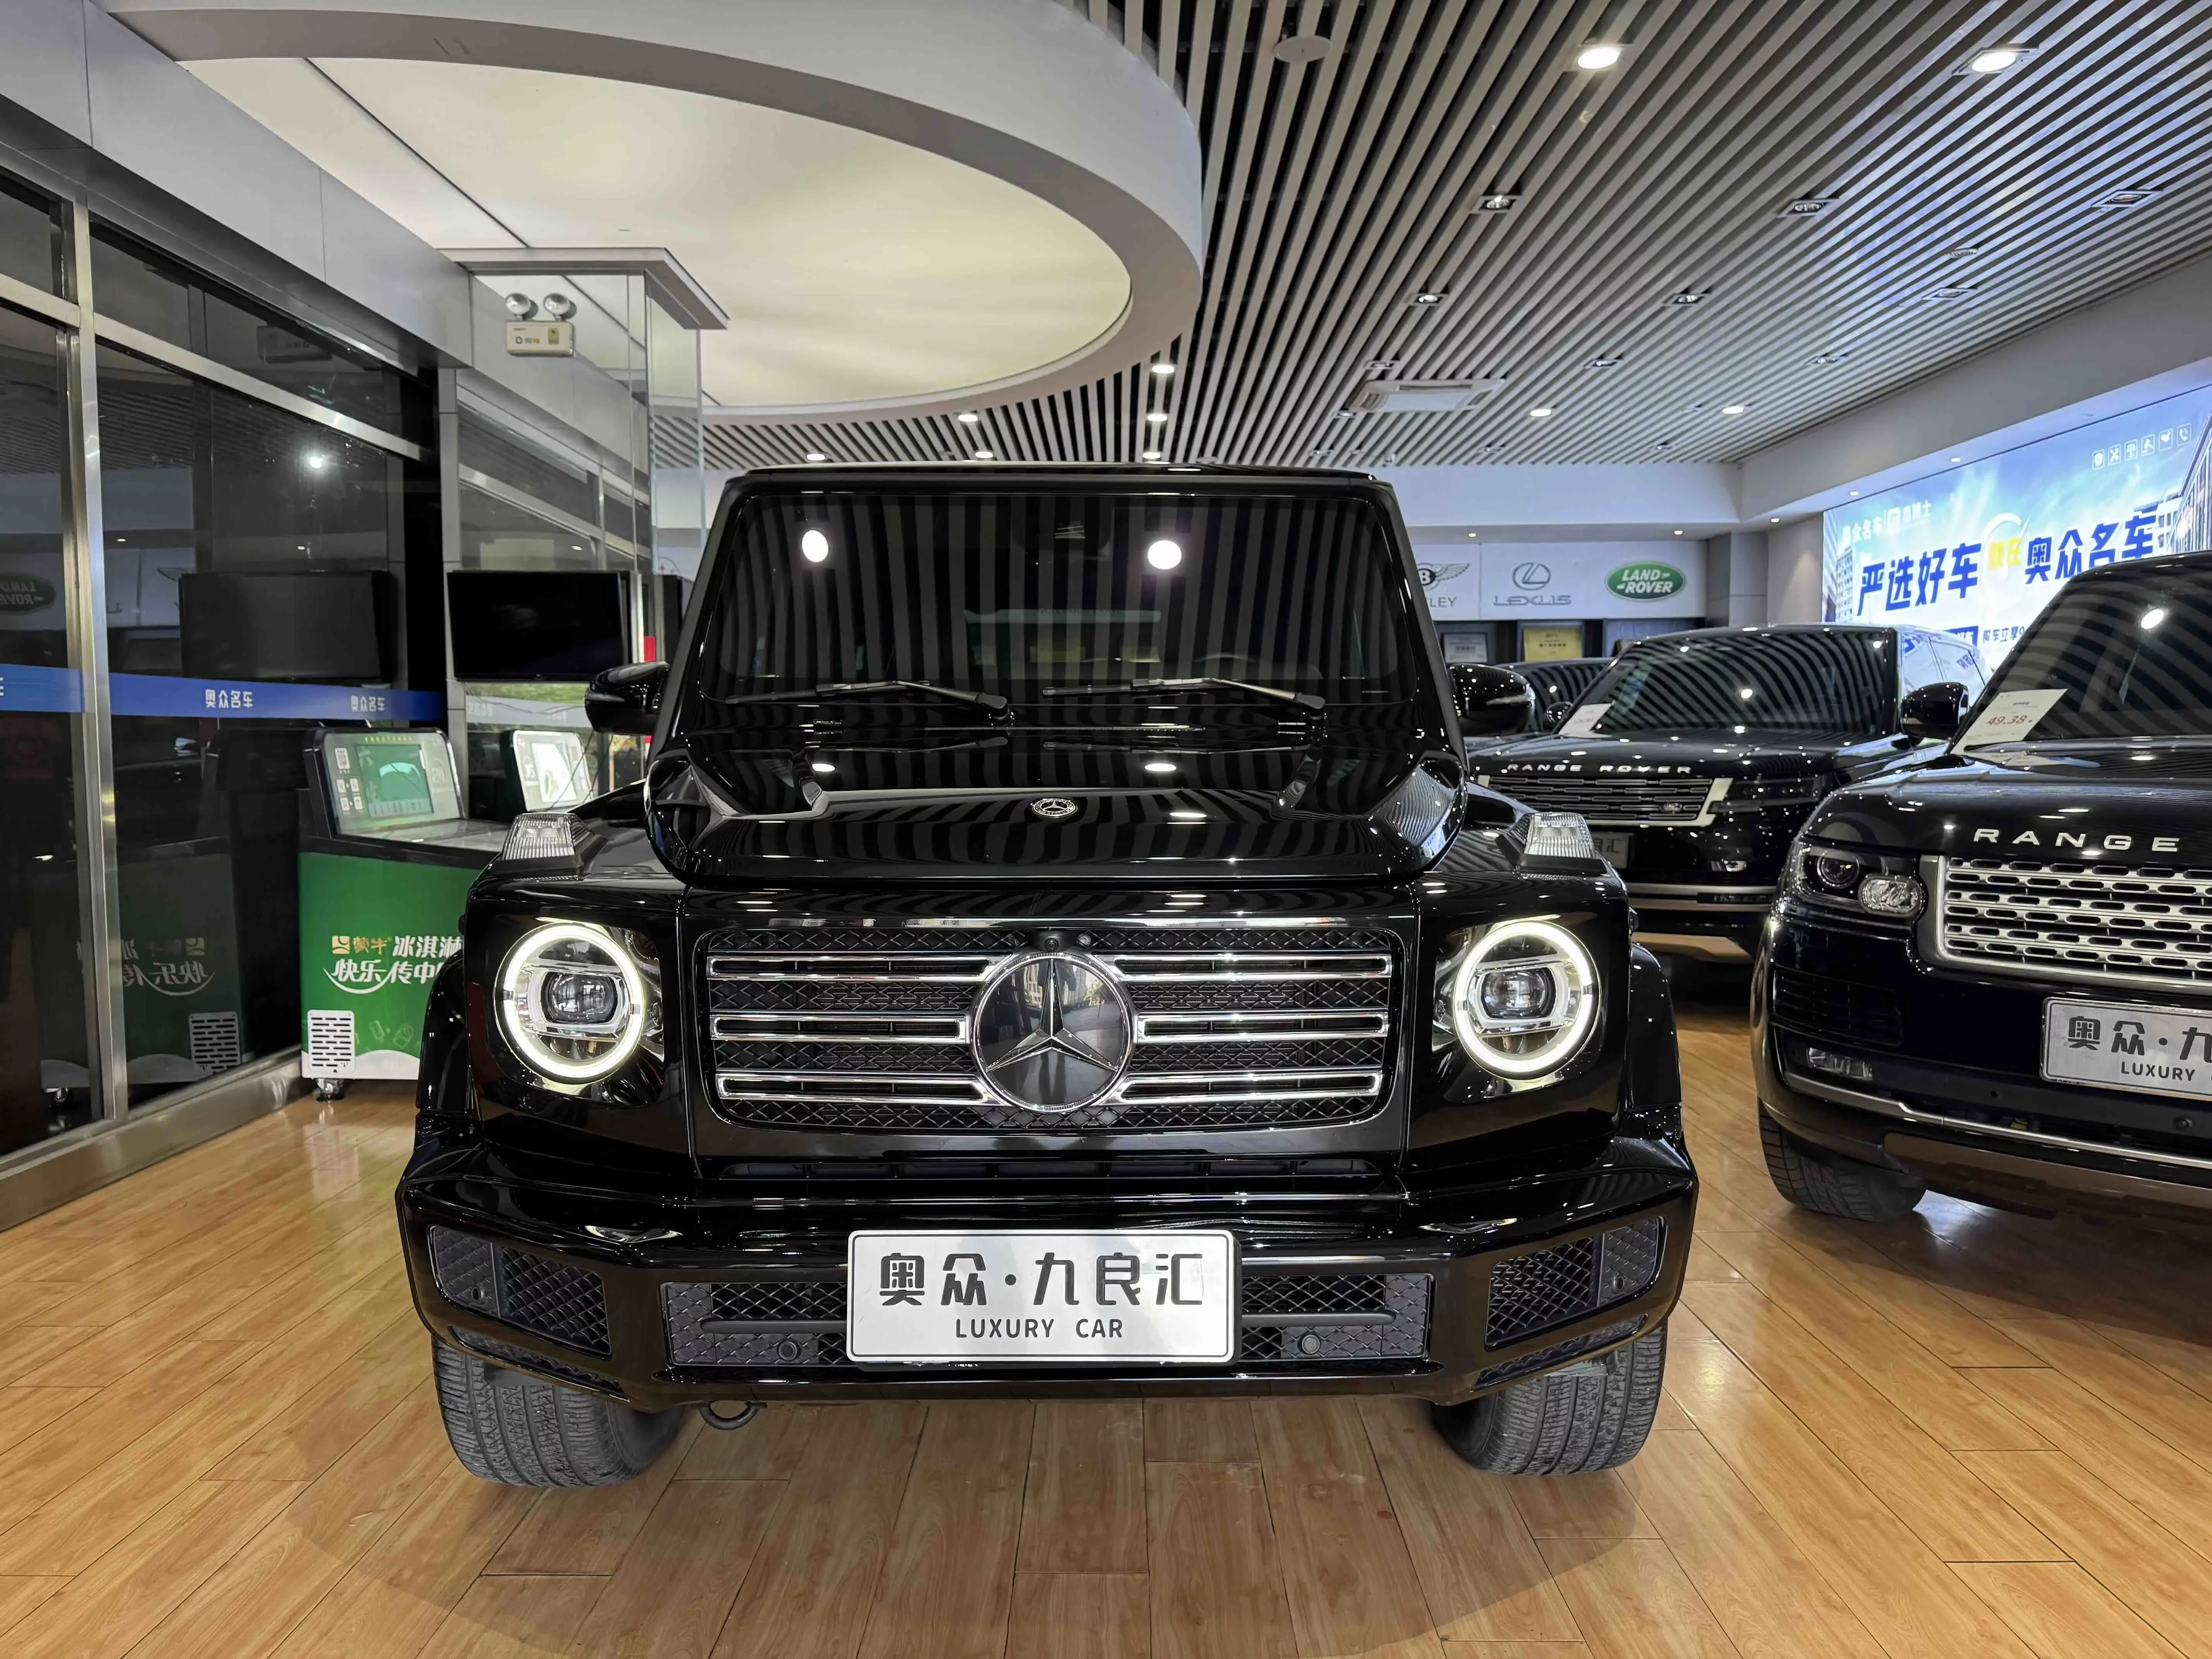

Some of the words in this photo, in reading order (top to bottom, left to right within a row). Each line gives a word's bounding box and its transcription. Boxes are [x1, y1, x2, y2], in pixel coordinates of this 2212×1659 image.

[1621, 568, 1661, 581] LAND
[1857, 543, 1982, 616] 严选好车
[2025, 515, 2157, 585] 奥众名车
[1625, 581, 1673, 593] ROVER
[1427, 597, 1458, 608] LEY
[1492, 595, 1572, 606] LEXUS
[205, 689, 253, 709] 奥众名车
[350, 696, 385, 712] 奥众名车
[1507, 764, 1582, 772] RANGE
[1599, 765, 1691, 774] ROVER
[1973, 828, 2180, 852] RANGE
[392, 935, 463, 958] 冰淇淋
[331, 958, 444, 984] 快乐传中
[2121, 1061, 2195, 1082] LUXURY
[956, 1319, 1054, 1338] LUXURY
[1076, 1319, 1123, 1338] CAR
